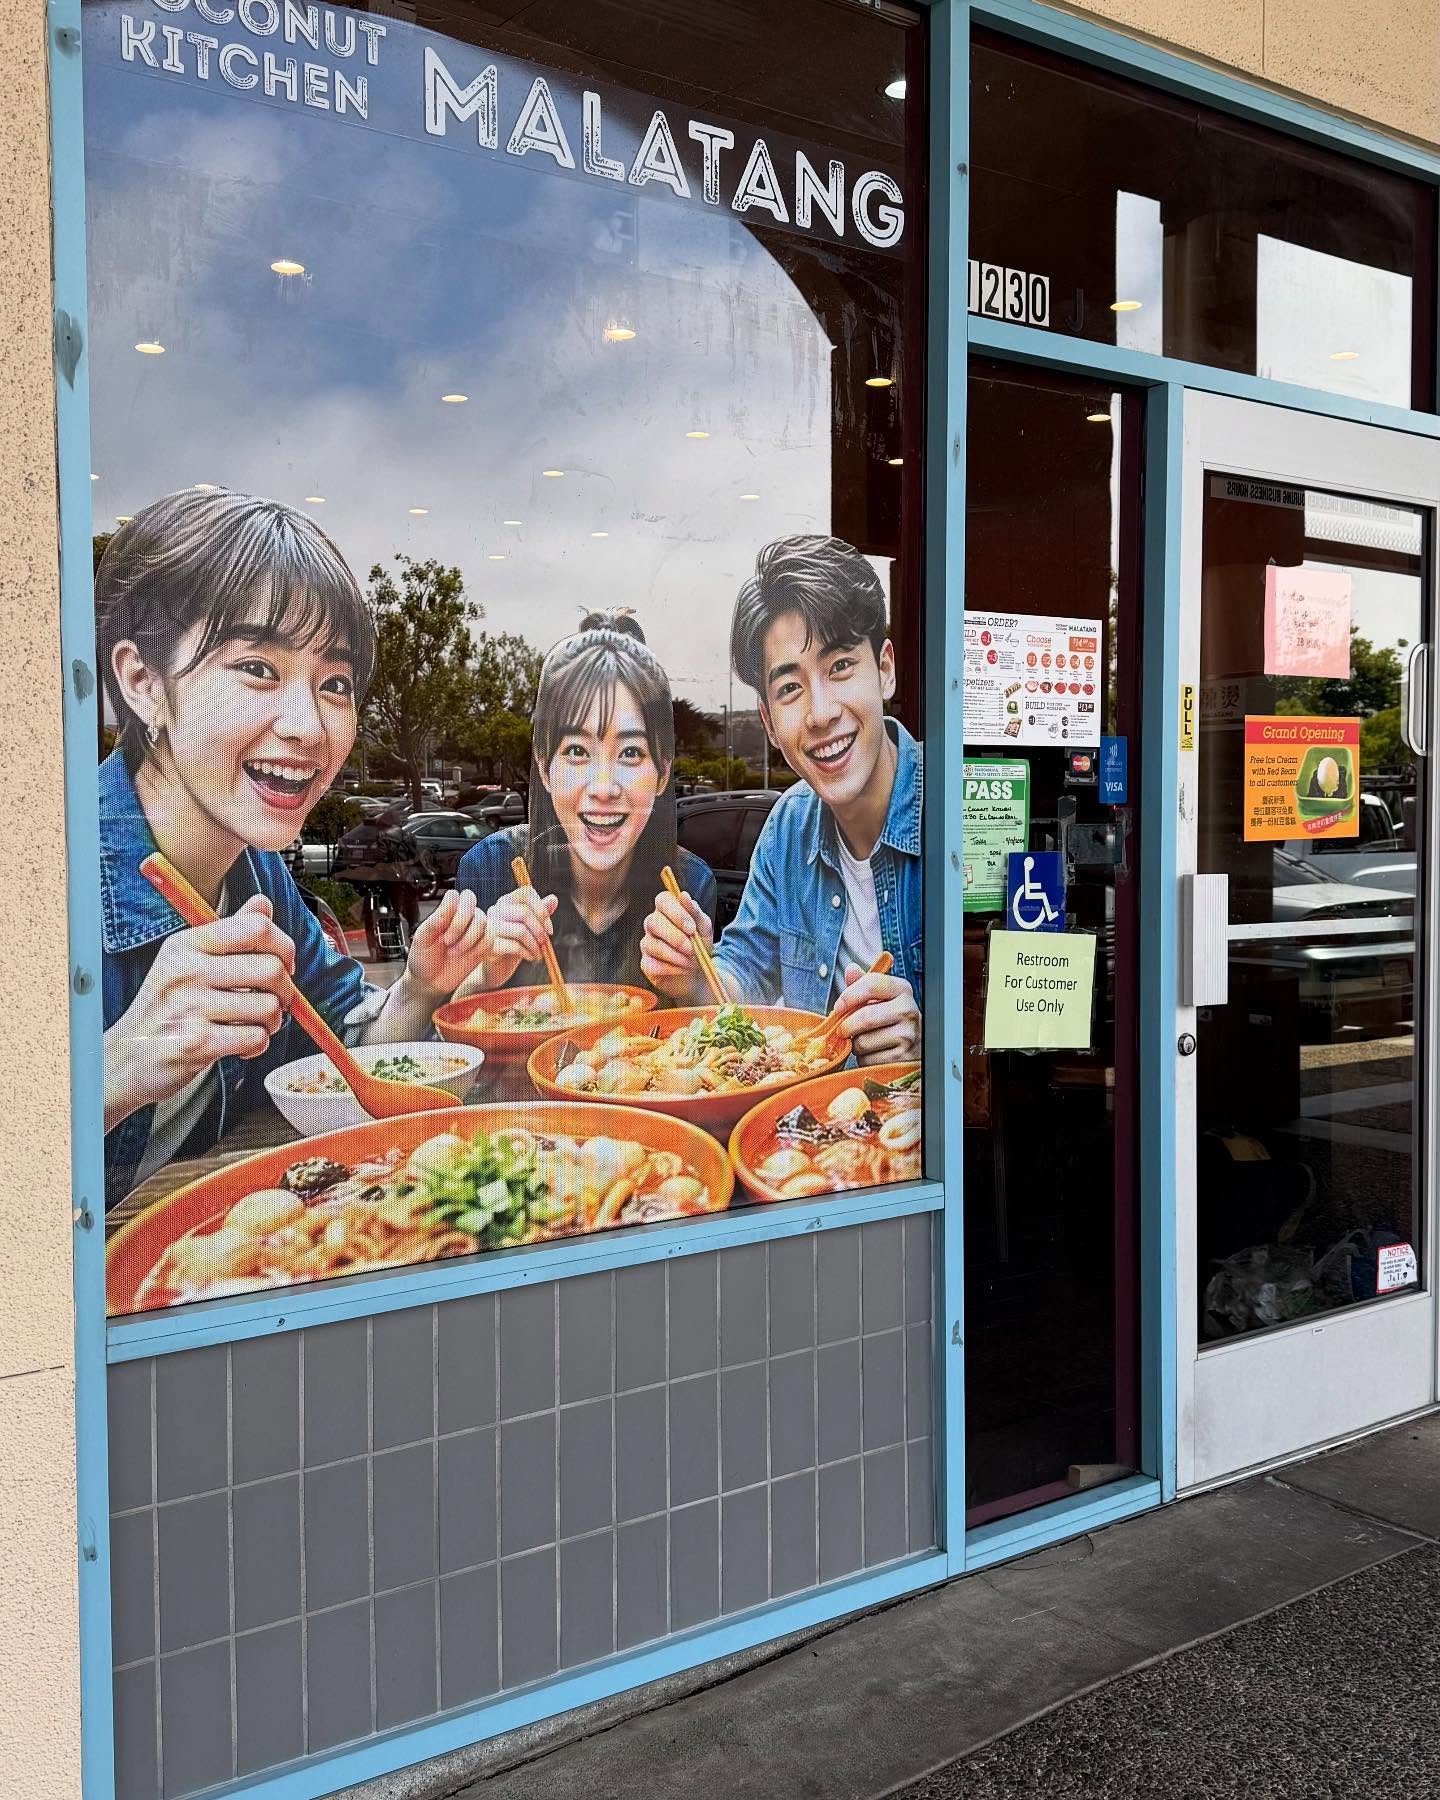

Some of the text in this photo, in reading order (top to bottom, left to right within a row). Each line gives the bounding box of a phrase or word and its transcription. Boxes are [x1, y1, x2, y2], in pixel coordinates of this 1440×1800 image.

[121, 14, 368, 120] KITCHEN
[424, 46, 905, 249] MALATANG
[987, 617, 1019, 628] ORDER?
[1026, 634, 1052, 644] Choose
[1025, 701, 1046, 710] BUILD
[1184, 687, 1193, 736] PULL
[1263, 725, 1346, 742] Grand Opening
[1249, 755, 1298, 764] Free Ice Cream
[1251, 767, 1297, 776] with Red Bean
[965, 780, 1013, 800] PASS
[1104, 781, 1123, 792] VISA
[1249, 779, 1256, 788] to
[1256, 779, 1266, 787] all
[1016, 952, 1069, 968] Restroom
[1004, 974, 1078, 991] For Customer
[1016, 998, 1065, 1016] Use Only
[1387, 1246, 1409, 1256] NOTICE
